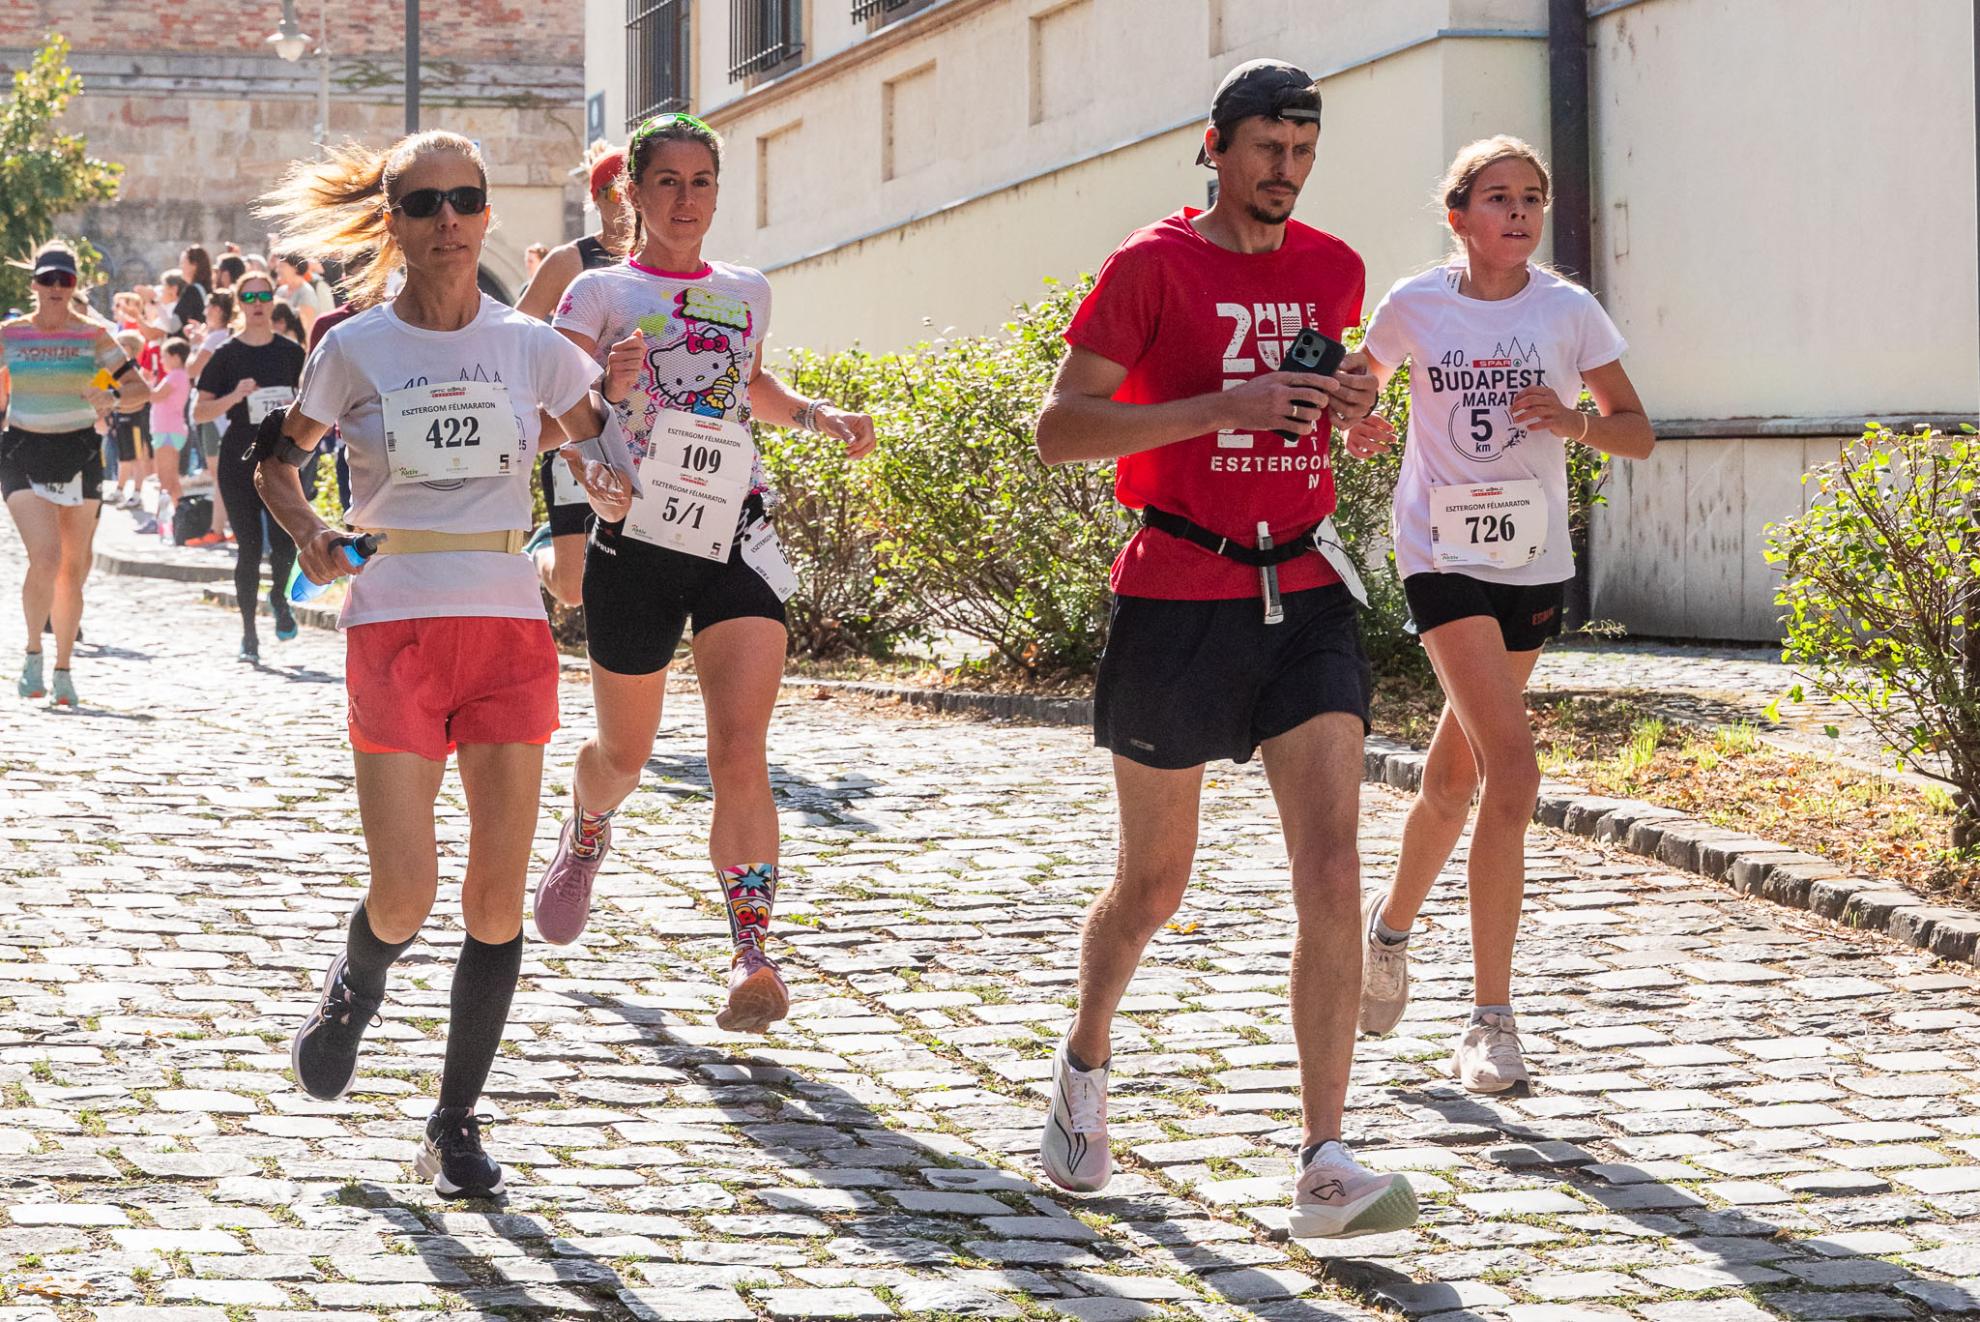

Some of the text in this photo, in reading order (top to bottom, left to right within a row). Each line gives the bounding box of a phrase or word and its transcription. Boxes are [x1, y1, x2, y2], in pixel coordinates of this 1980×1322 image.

[1440, 350, 1469, 368] 40.
[1428, 366, 1545, 393] BUDAPEST
[402, 401, 496, 416] ESZTERGOM FÉLMARATON
[1462, 391, 1518, 407] MARAT
[426, 416, 480, 449] 422
[668, 428, 741, 448] ESZTERGOM FÉLMARATON
[1471, 409, 1493, 442] 5
[681, 444, 722, 474] 109
[1475, 443, 1491, 453] km
[652, 479, 688, 495] ESZTERGOM
[688, 488, 727, 505] FÉLMARATON
[662, 496, 705, 530] 5/1
[1445, 499, 1530, 513] ESZTERGOM FÉLMARATON
[1465, 513, 1515, 544] 726
